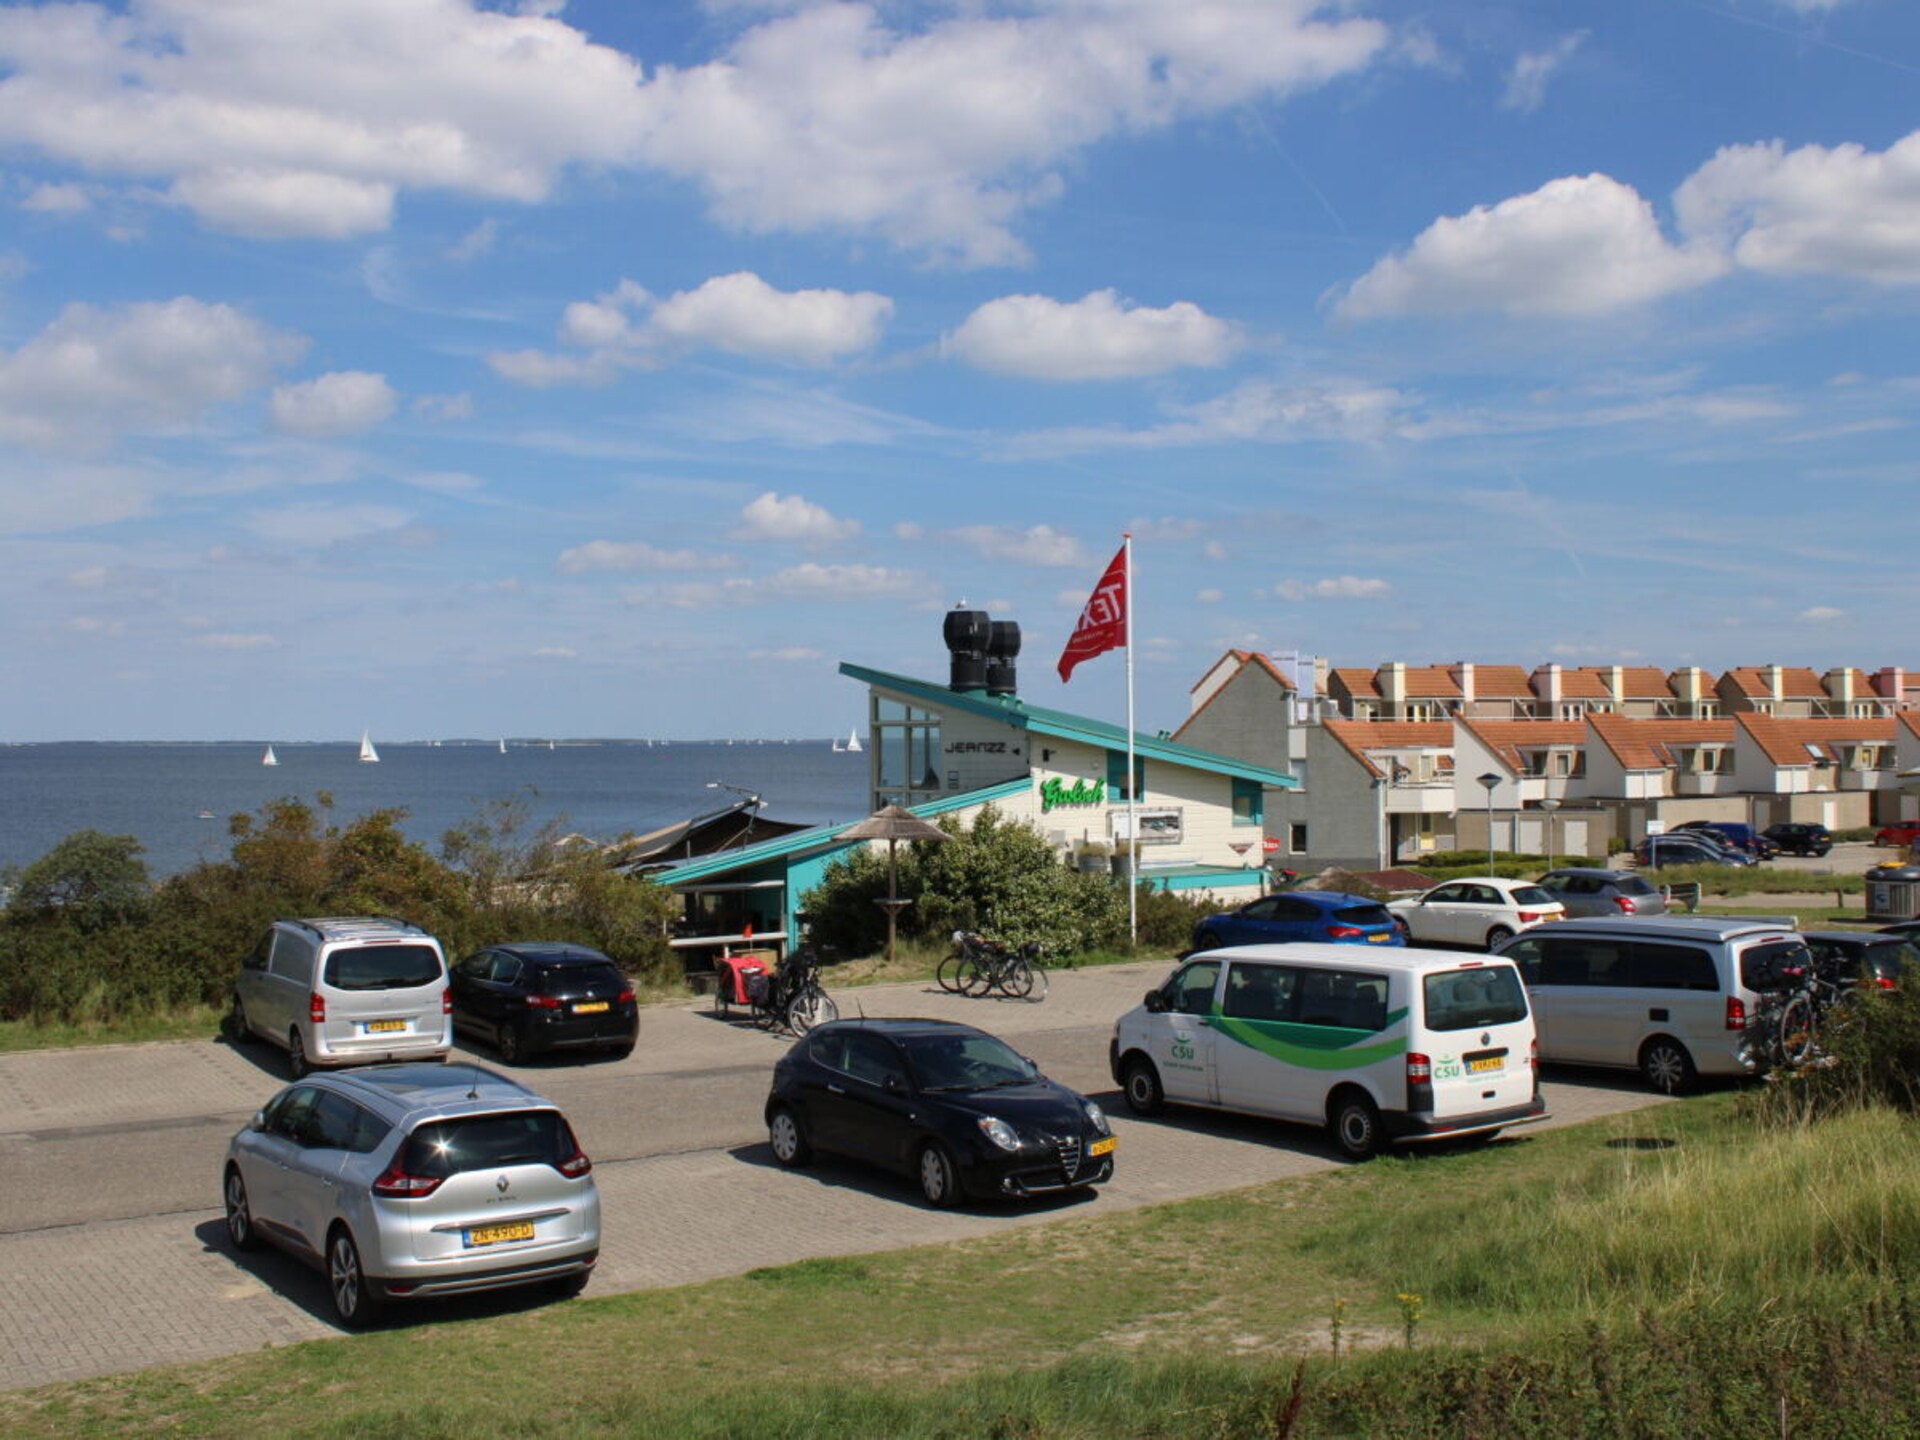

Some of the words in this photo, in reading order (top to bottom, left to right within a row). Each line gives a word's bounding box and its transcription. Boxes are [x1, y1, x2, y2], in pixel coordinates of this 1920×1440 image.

[945, 741, 1006, 754] JEANZZ
[1171, 1044, 1195, 1060] CSU
[1434, 1066, 1460, 1079] CSU
